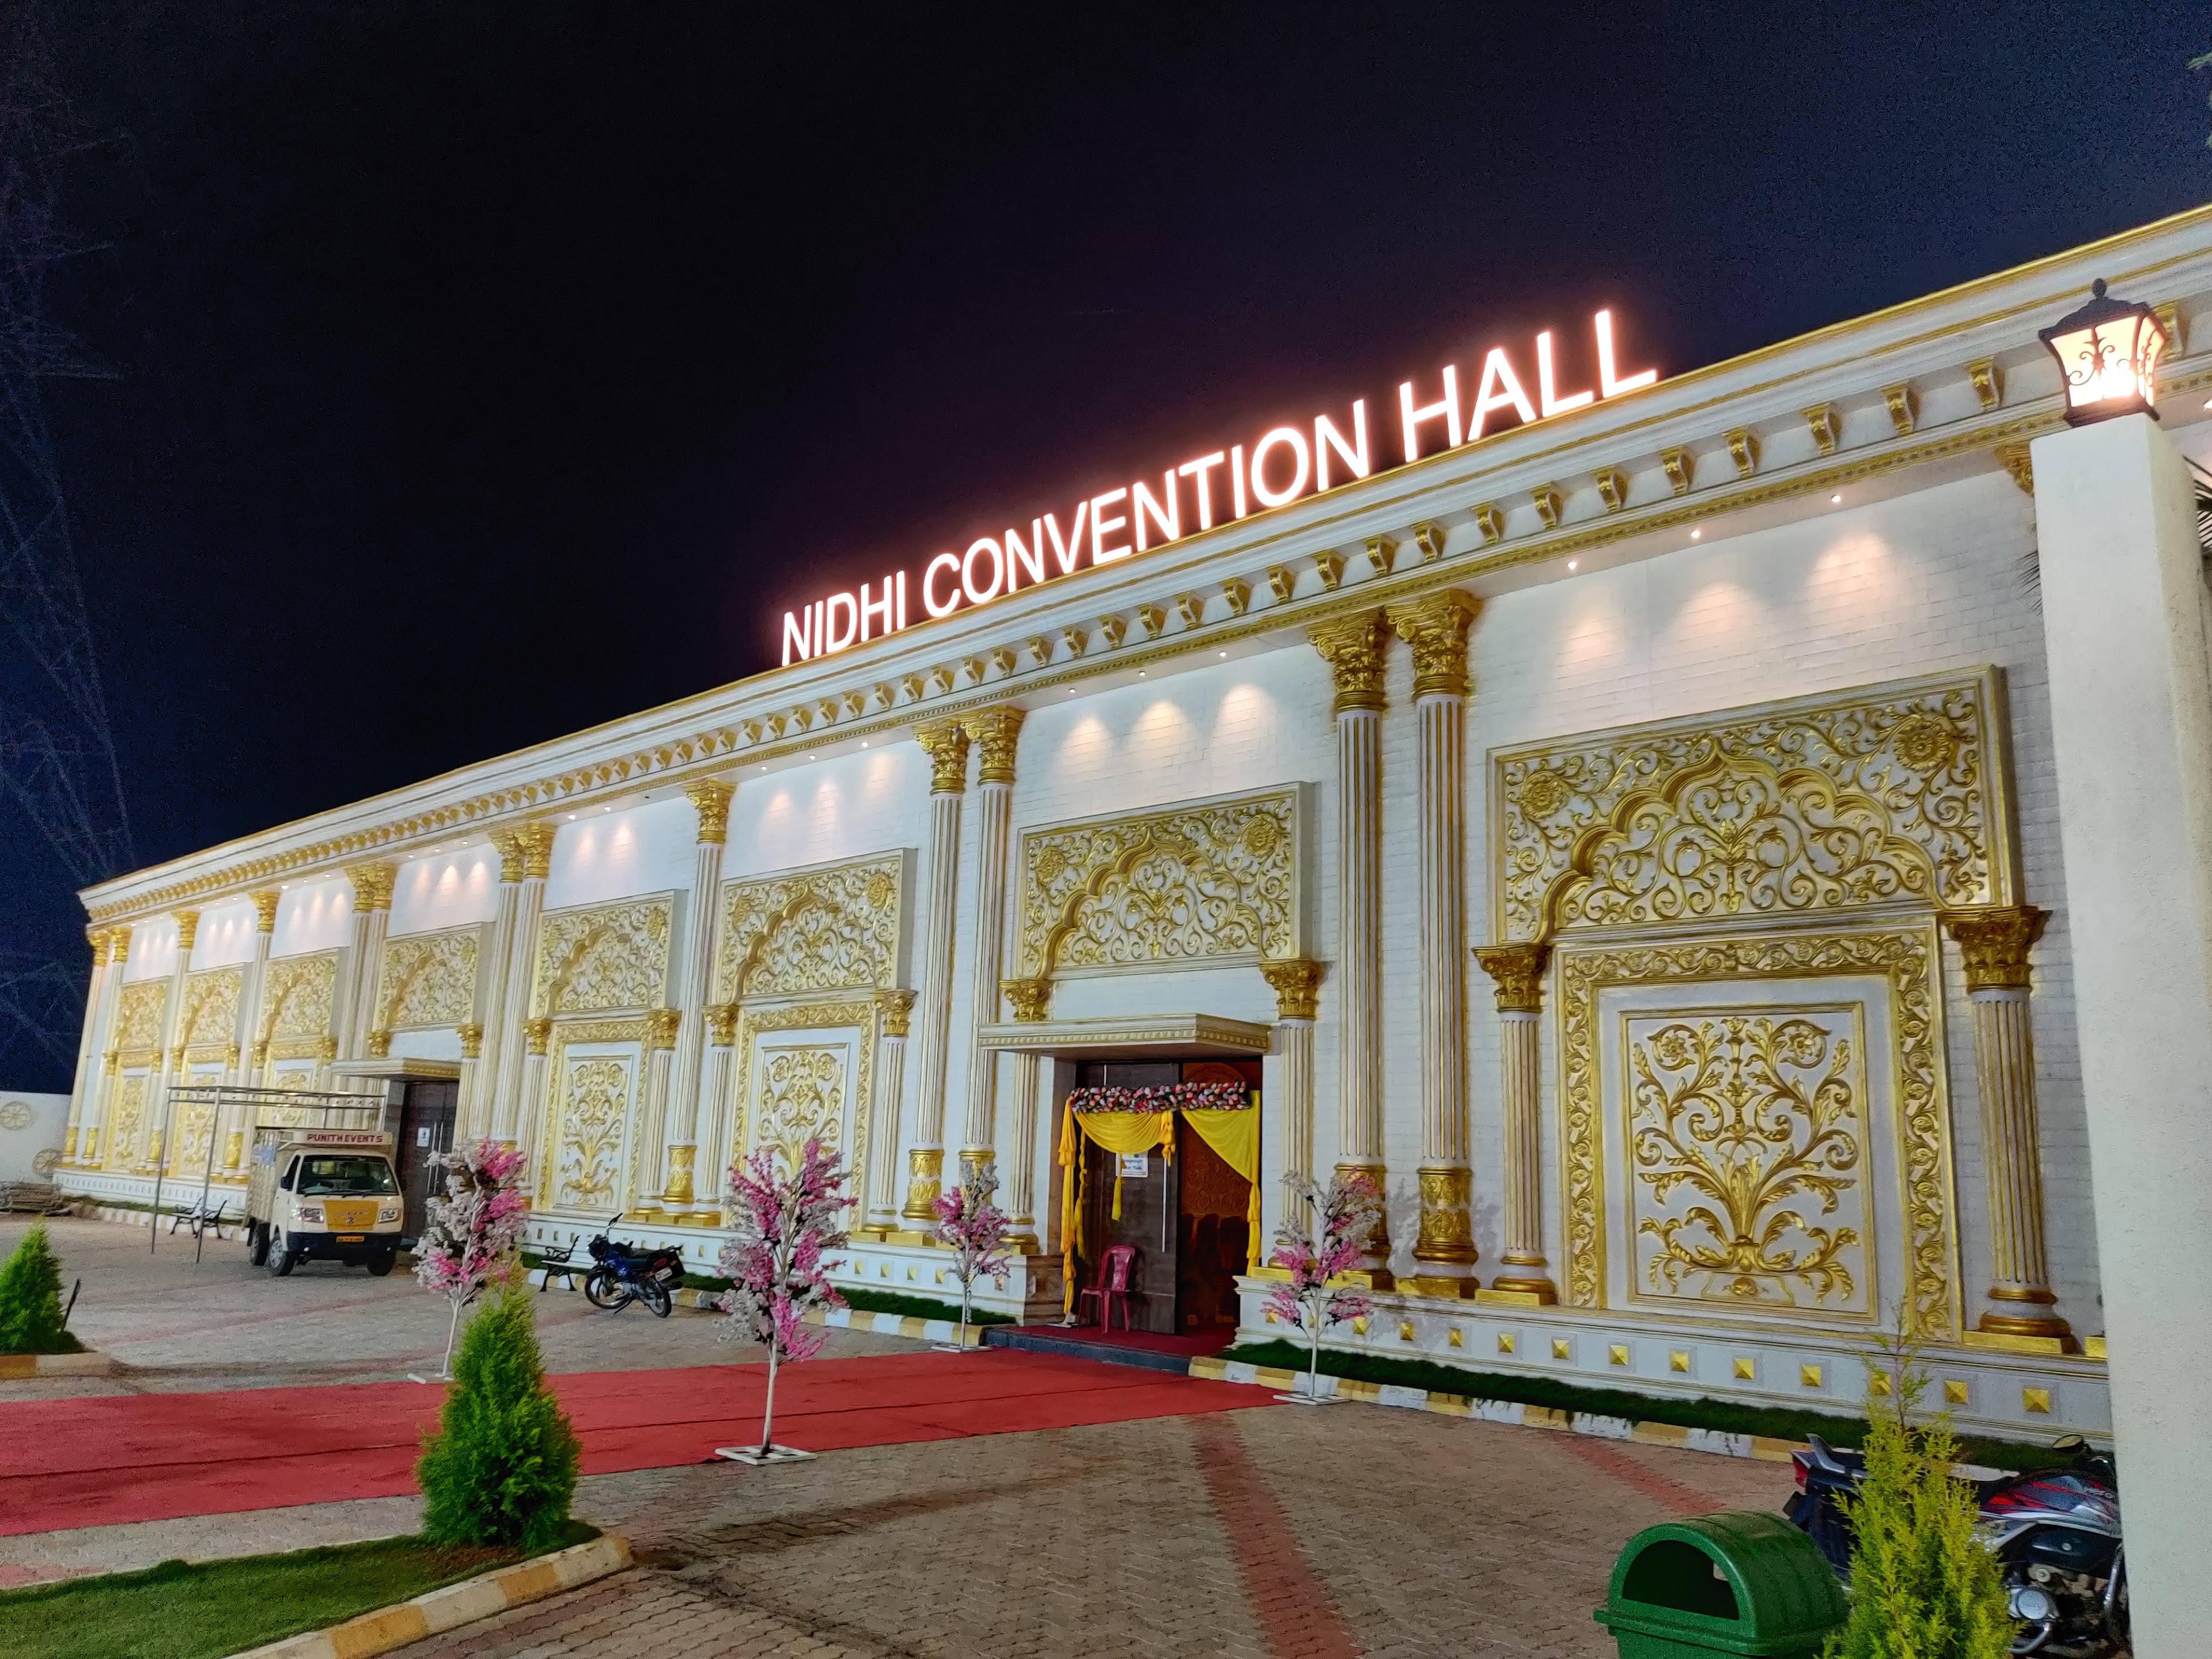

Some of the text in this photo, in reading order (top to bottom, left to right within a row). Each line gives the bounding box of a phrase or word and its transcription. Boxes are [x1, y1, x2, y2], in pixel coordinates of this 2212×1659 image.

[782, 309, 1657, 667] NIDHI CONVENTION HALL
[307, 1133, 383, 1142] PUNITH EVENTS
